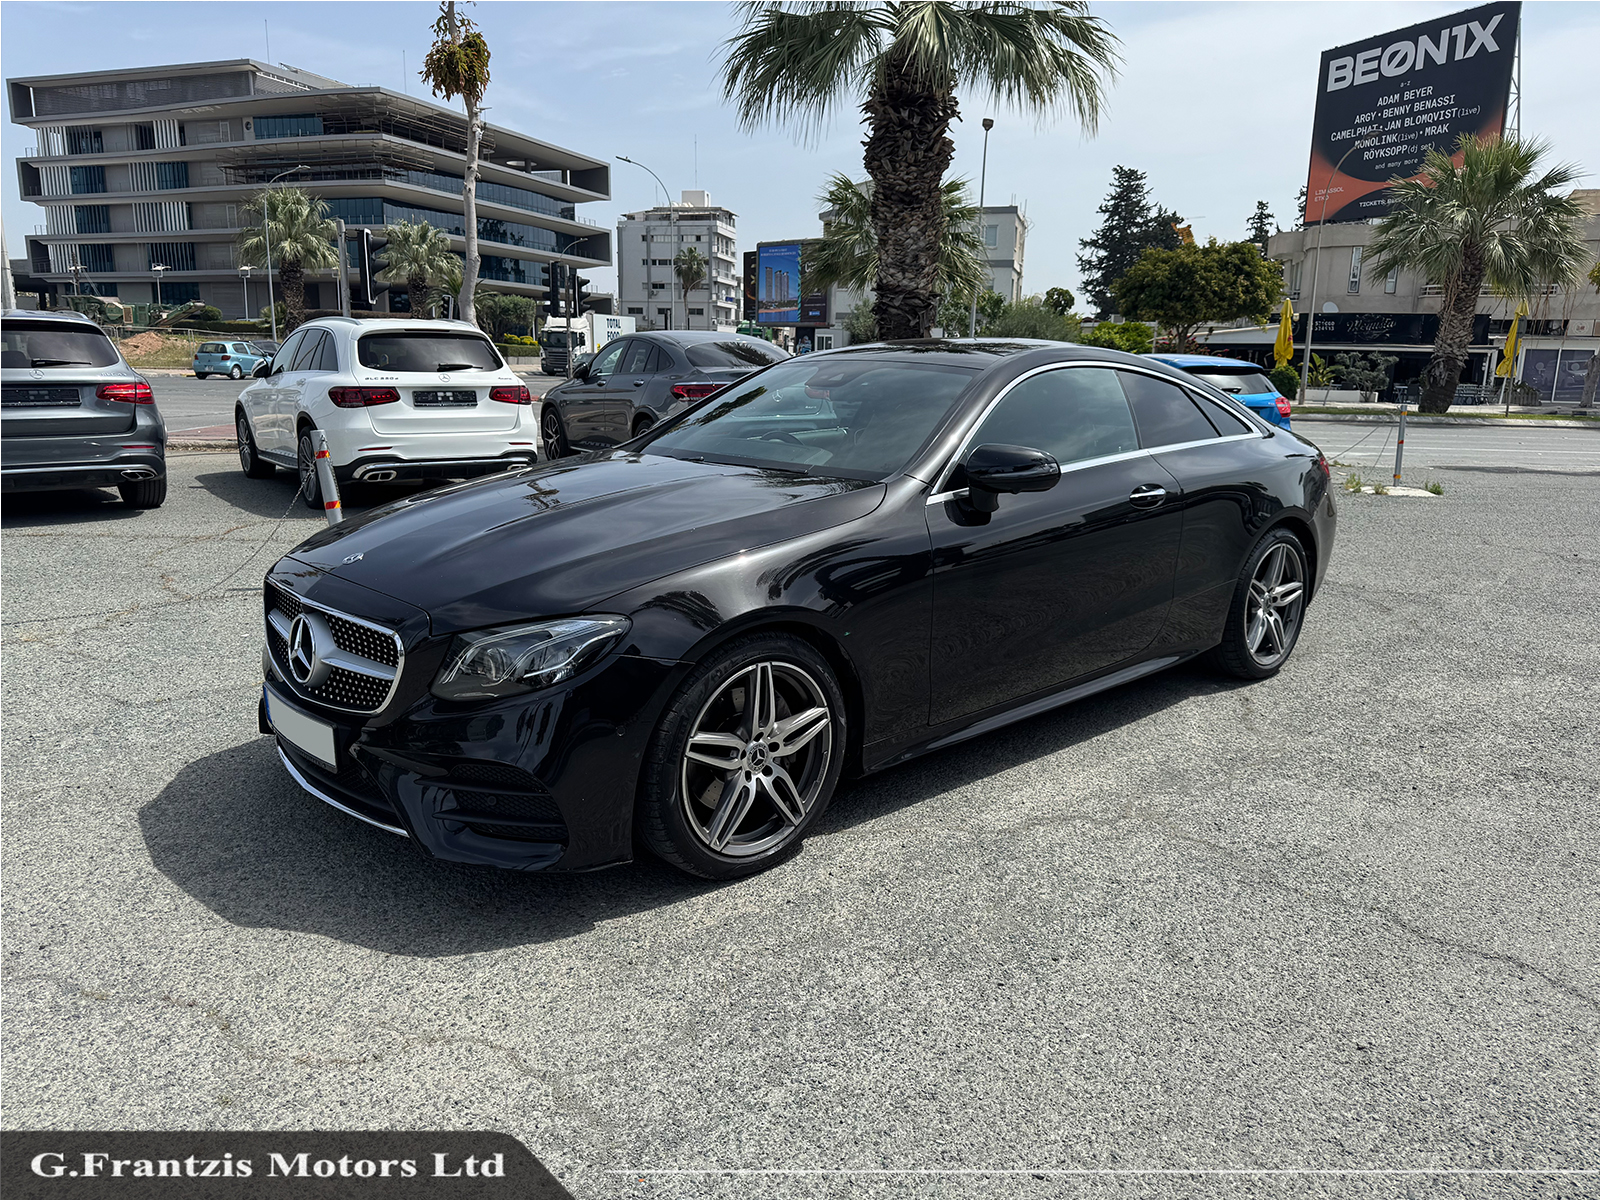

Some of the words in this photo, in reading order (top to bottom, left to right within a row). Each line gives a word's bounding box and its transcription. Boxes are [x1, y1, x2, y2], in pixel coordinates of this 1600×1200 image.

[1377, 93, 1400, 107] ADAM
[1403, 86, 1434, 101] BEYER
[1354, 111, 1377, 124] ARGY
[1382, 104, 1412, 119] BENNY
[1413, 94, 1456, 112] BENASSI
[1330, 123, 1379, 142] CAMELPHAT
[1384, 119, 1402, 131] JAN
[1424, 123, 1450, 137] MRAK
[1375, 162, 1386, 170] and
[1387, 160, 1402, 169] many
[1404, 157, 1419, 166] more
[606, 318, 621, 329] TOTAL
